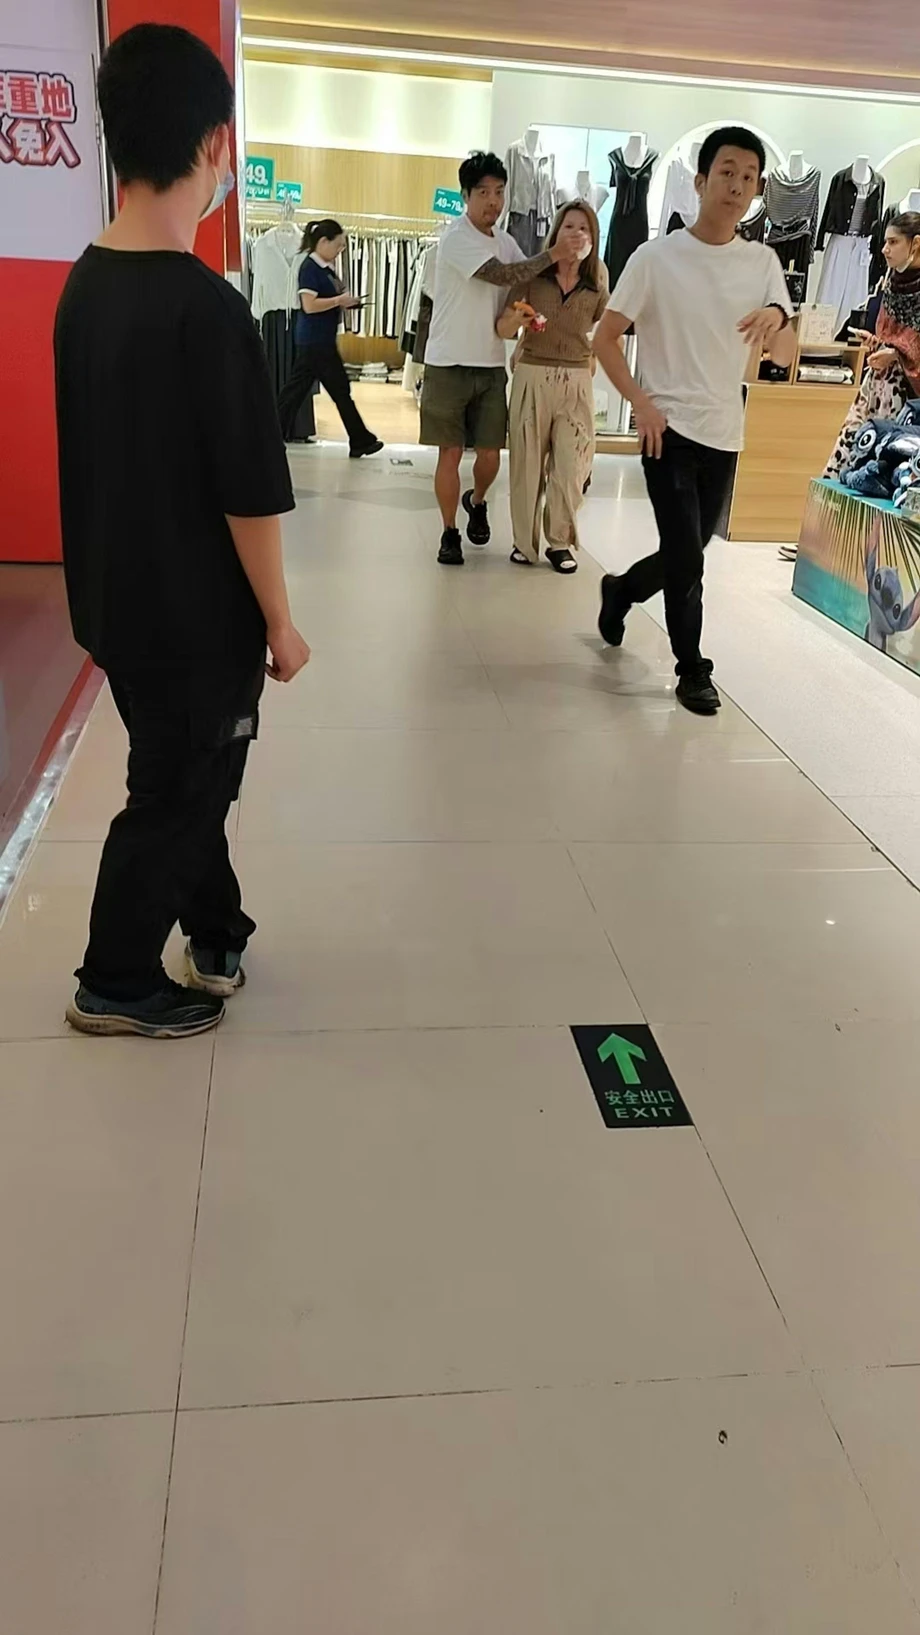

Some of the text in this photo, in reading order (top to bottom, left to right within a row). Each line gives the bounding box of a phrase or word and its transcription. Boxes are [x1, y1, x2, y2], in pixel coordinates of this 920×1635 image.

[0, 72, 76, 122] 重地
[604, 1089, 675, 1105] 安全出口
[614, 1106, 673, 1118] EXIT
